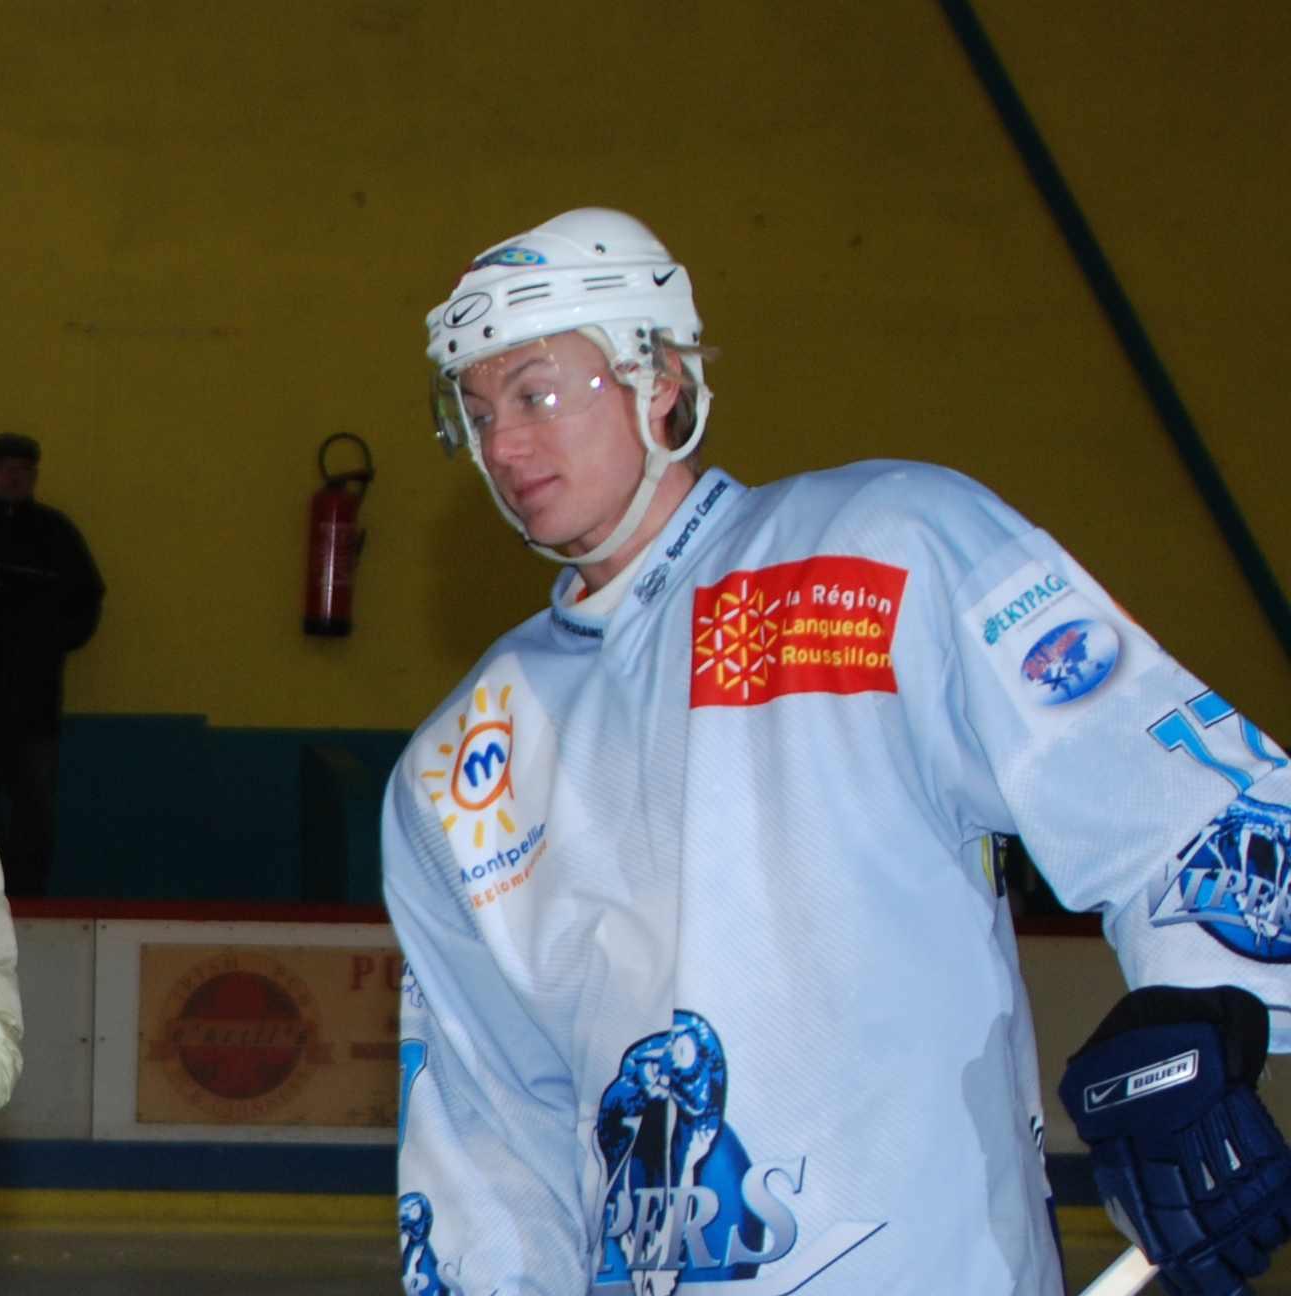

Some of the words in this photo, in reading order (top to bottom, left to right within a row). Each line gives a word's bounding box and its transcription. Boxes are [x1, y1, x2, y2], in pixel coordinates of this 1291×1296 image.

[812, 583, 893, 615] Région
[781, 617, 882, 639] Languedo
[780, 645, 894, 669] Roussillon
[1132, 1061, 1188, 1091] BAUER
